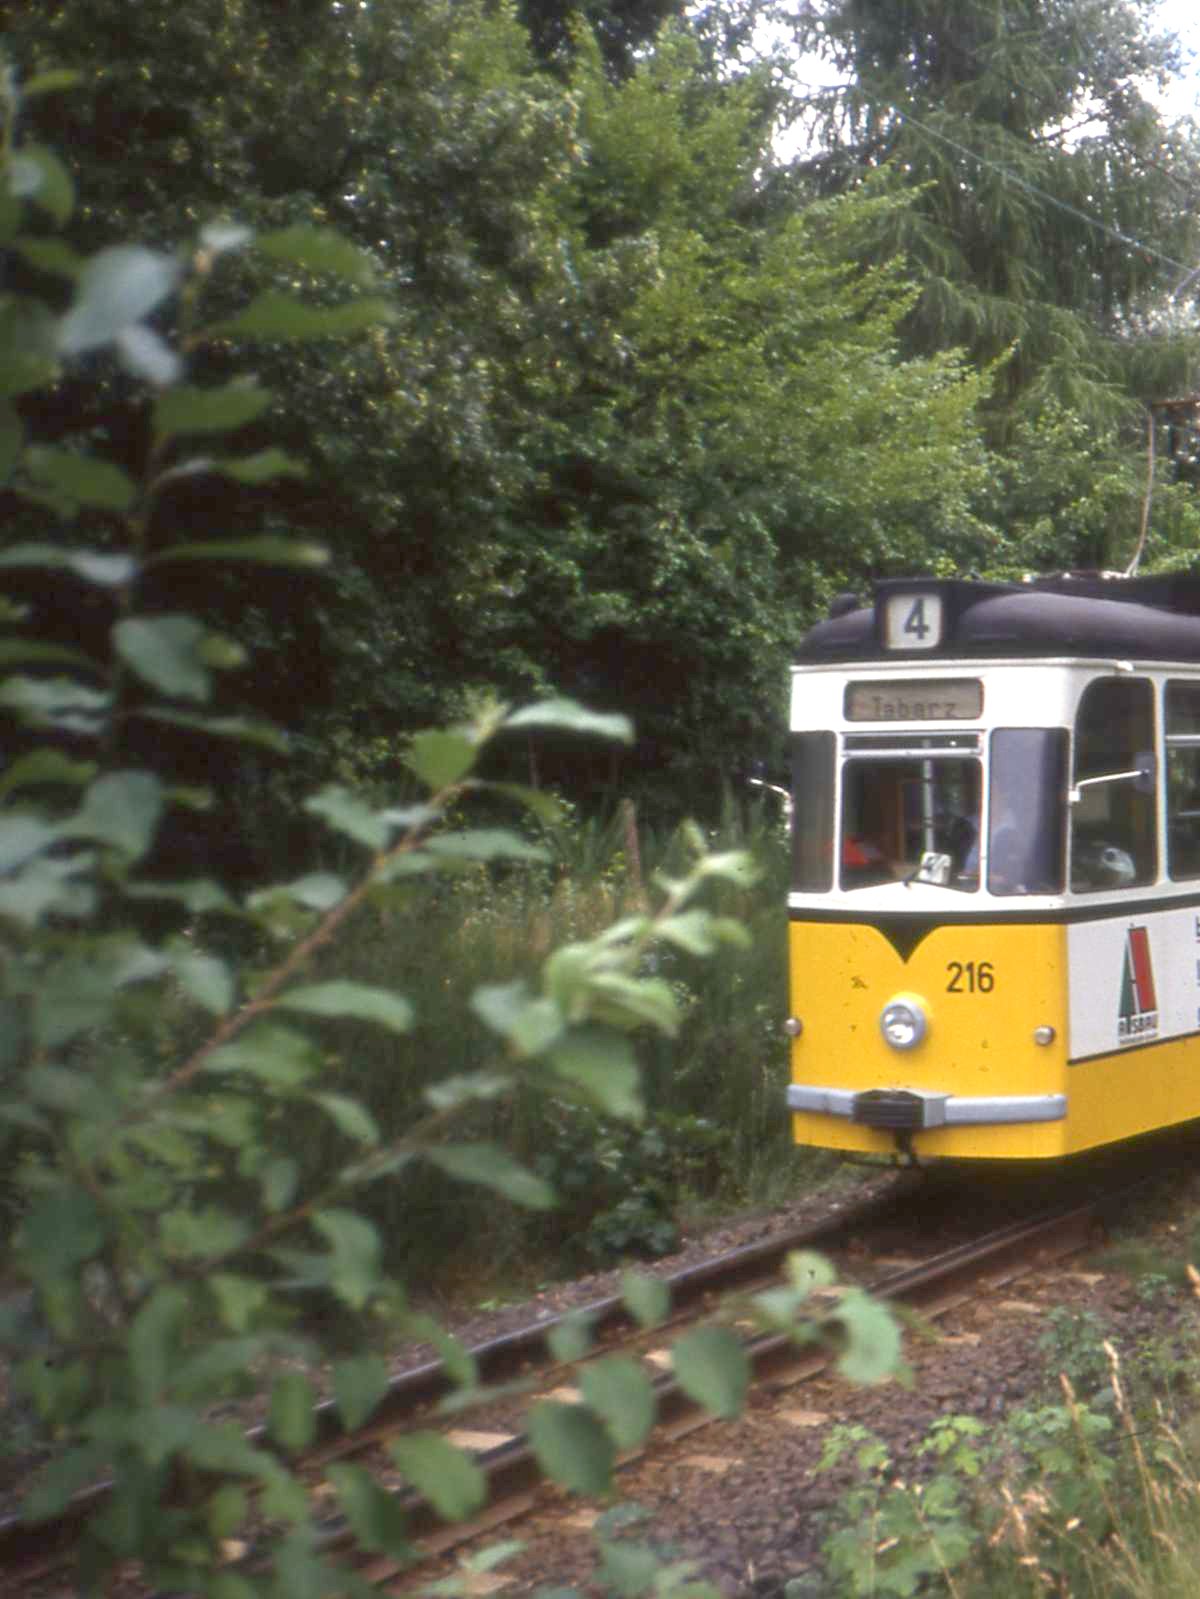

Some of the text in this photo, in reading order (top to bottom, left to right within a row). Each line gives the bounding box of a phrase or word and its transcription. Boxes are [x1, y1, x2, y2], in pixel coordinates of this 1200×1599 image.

[903, 597, 931, 640] 4
[872, 696, 957, 719] Tabarz
[946, 961, 994, 993] 216
